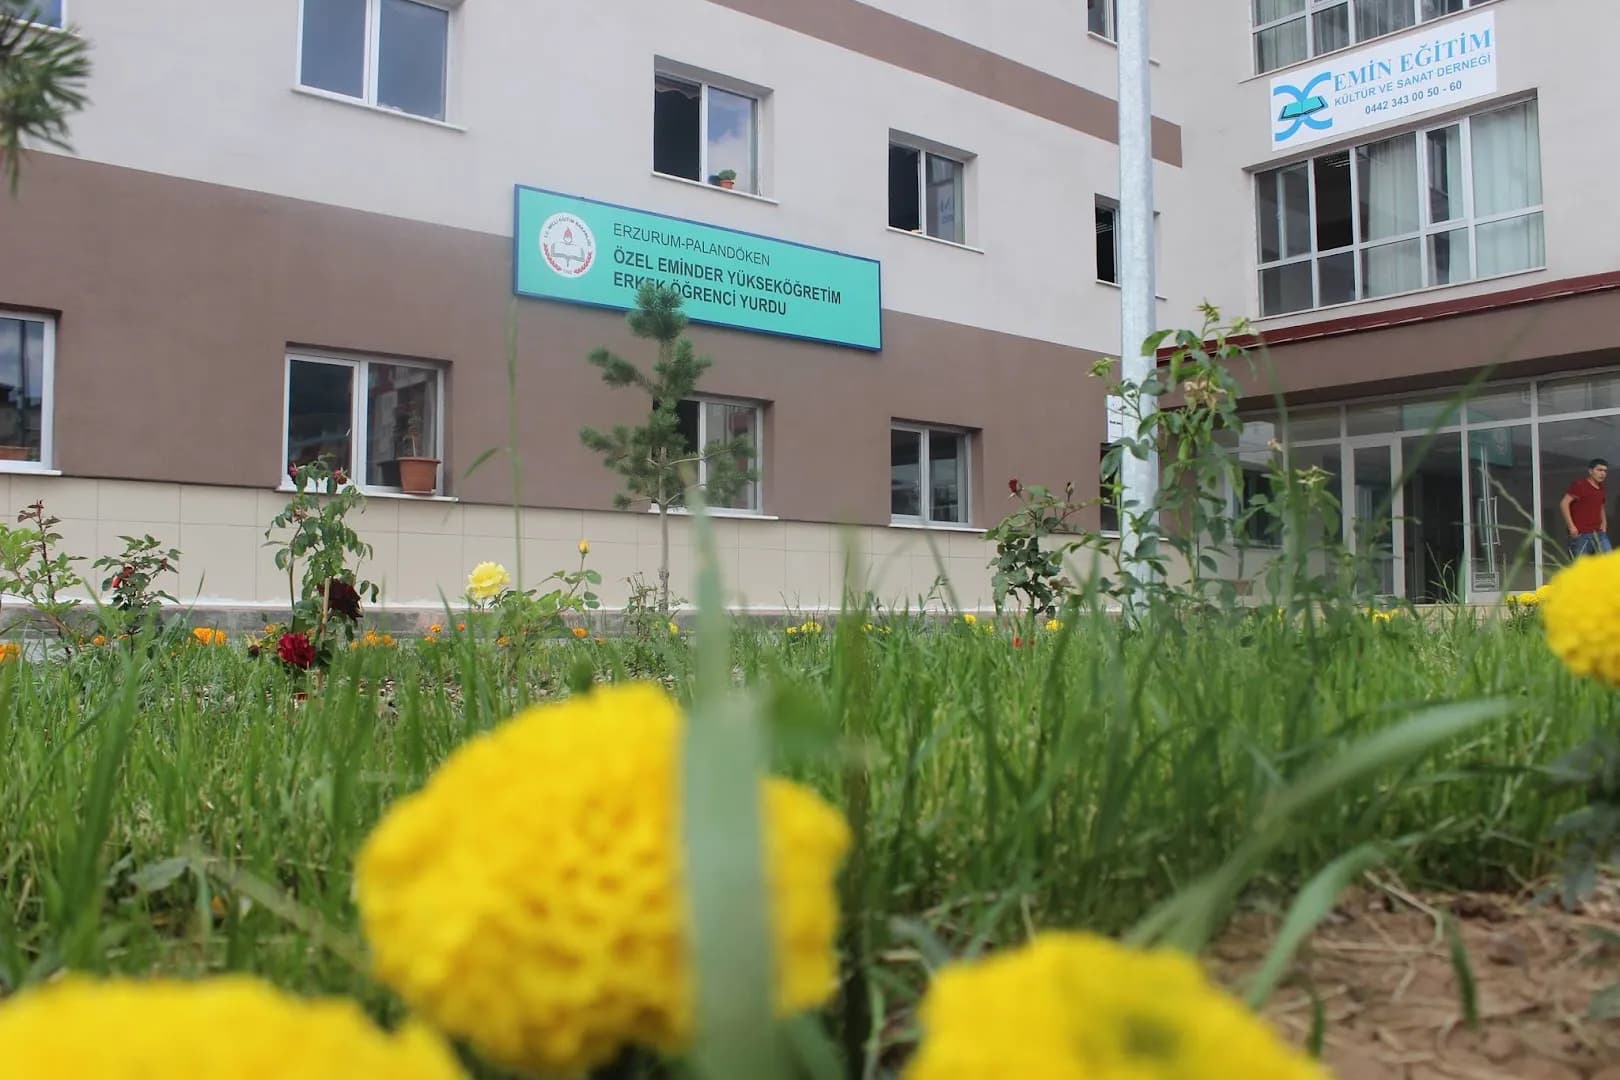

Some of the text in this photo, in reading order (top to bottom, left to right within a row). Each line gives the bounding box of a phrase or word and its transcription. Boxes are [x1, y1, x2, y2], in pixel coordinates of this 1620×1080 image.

[1334, 28, 1492, 92] EMİN EĞİTİM
[1380, 81, 1393, 94] VE
[1396, 70, 1434, 89] SANAT
[1365, 100, 1389, 114] 0442
[1391, 95, 1409, 108] 343
[1411, 90, 1424, 101] 00
[1427, 86, 1440, 97] 50
[1449, 80, 1462, 92] 60
[613, 222, 770, 267] ERZURUM-PALANDÖKEN
[613, 245, 841, 305] ÖZEL EMİNDER YÜKSEKÖĞRETİM
[613, 271, 667, 291] ERKK
[739, 294, 787, 316] YURDU
